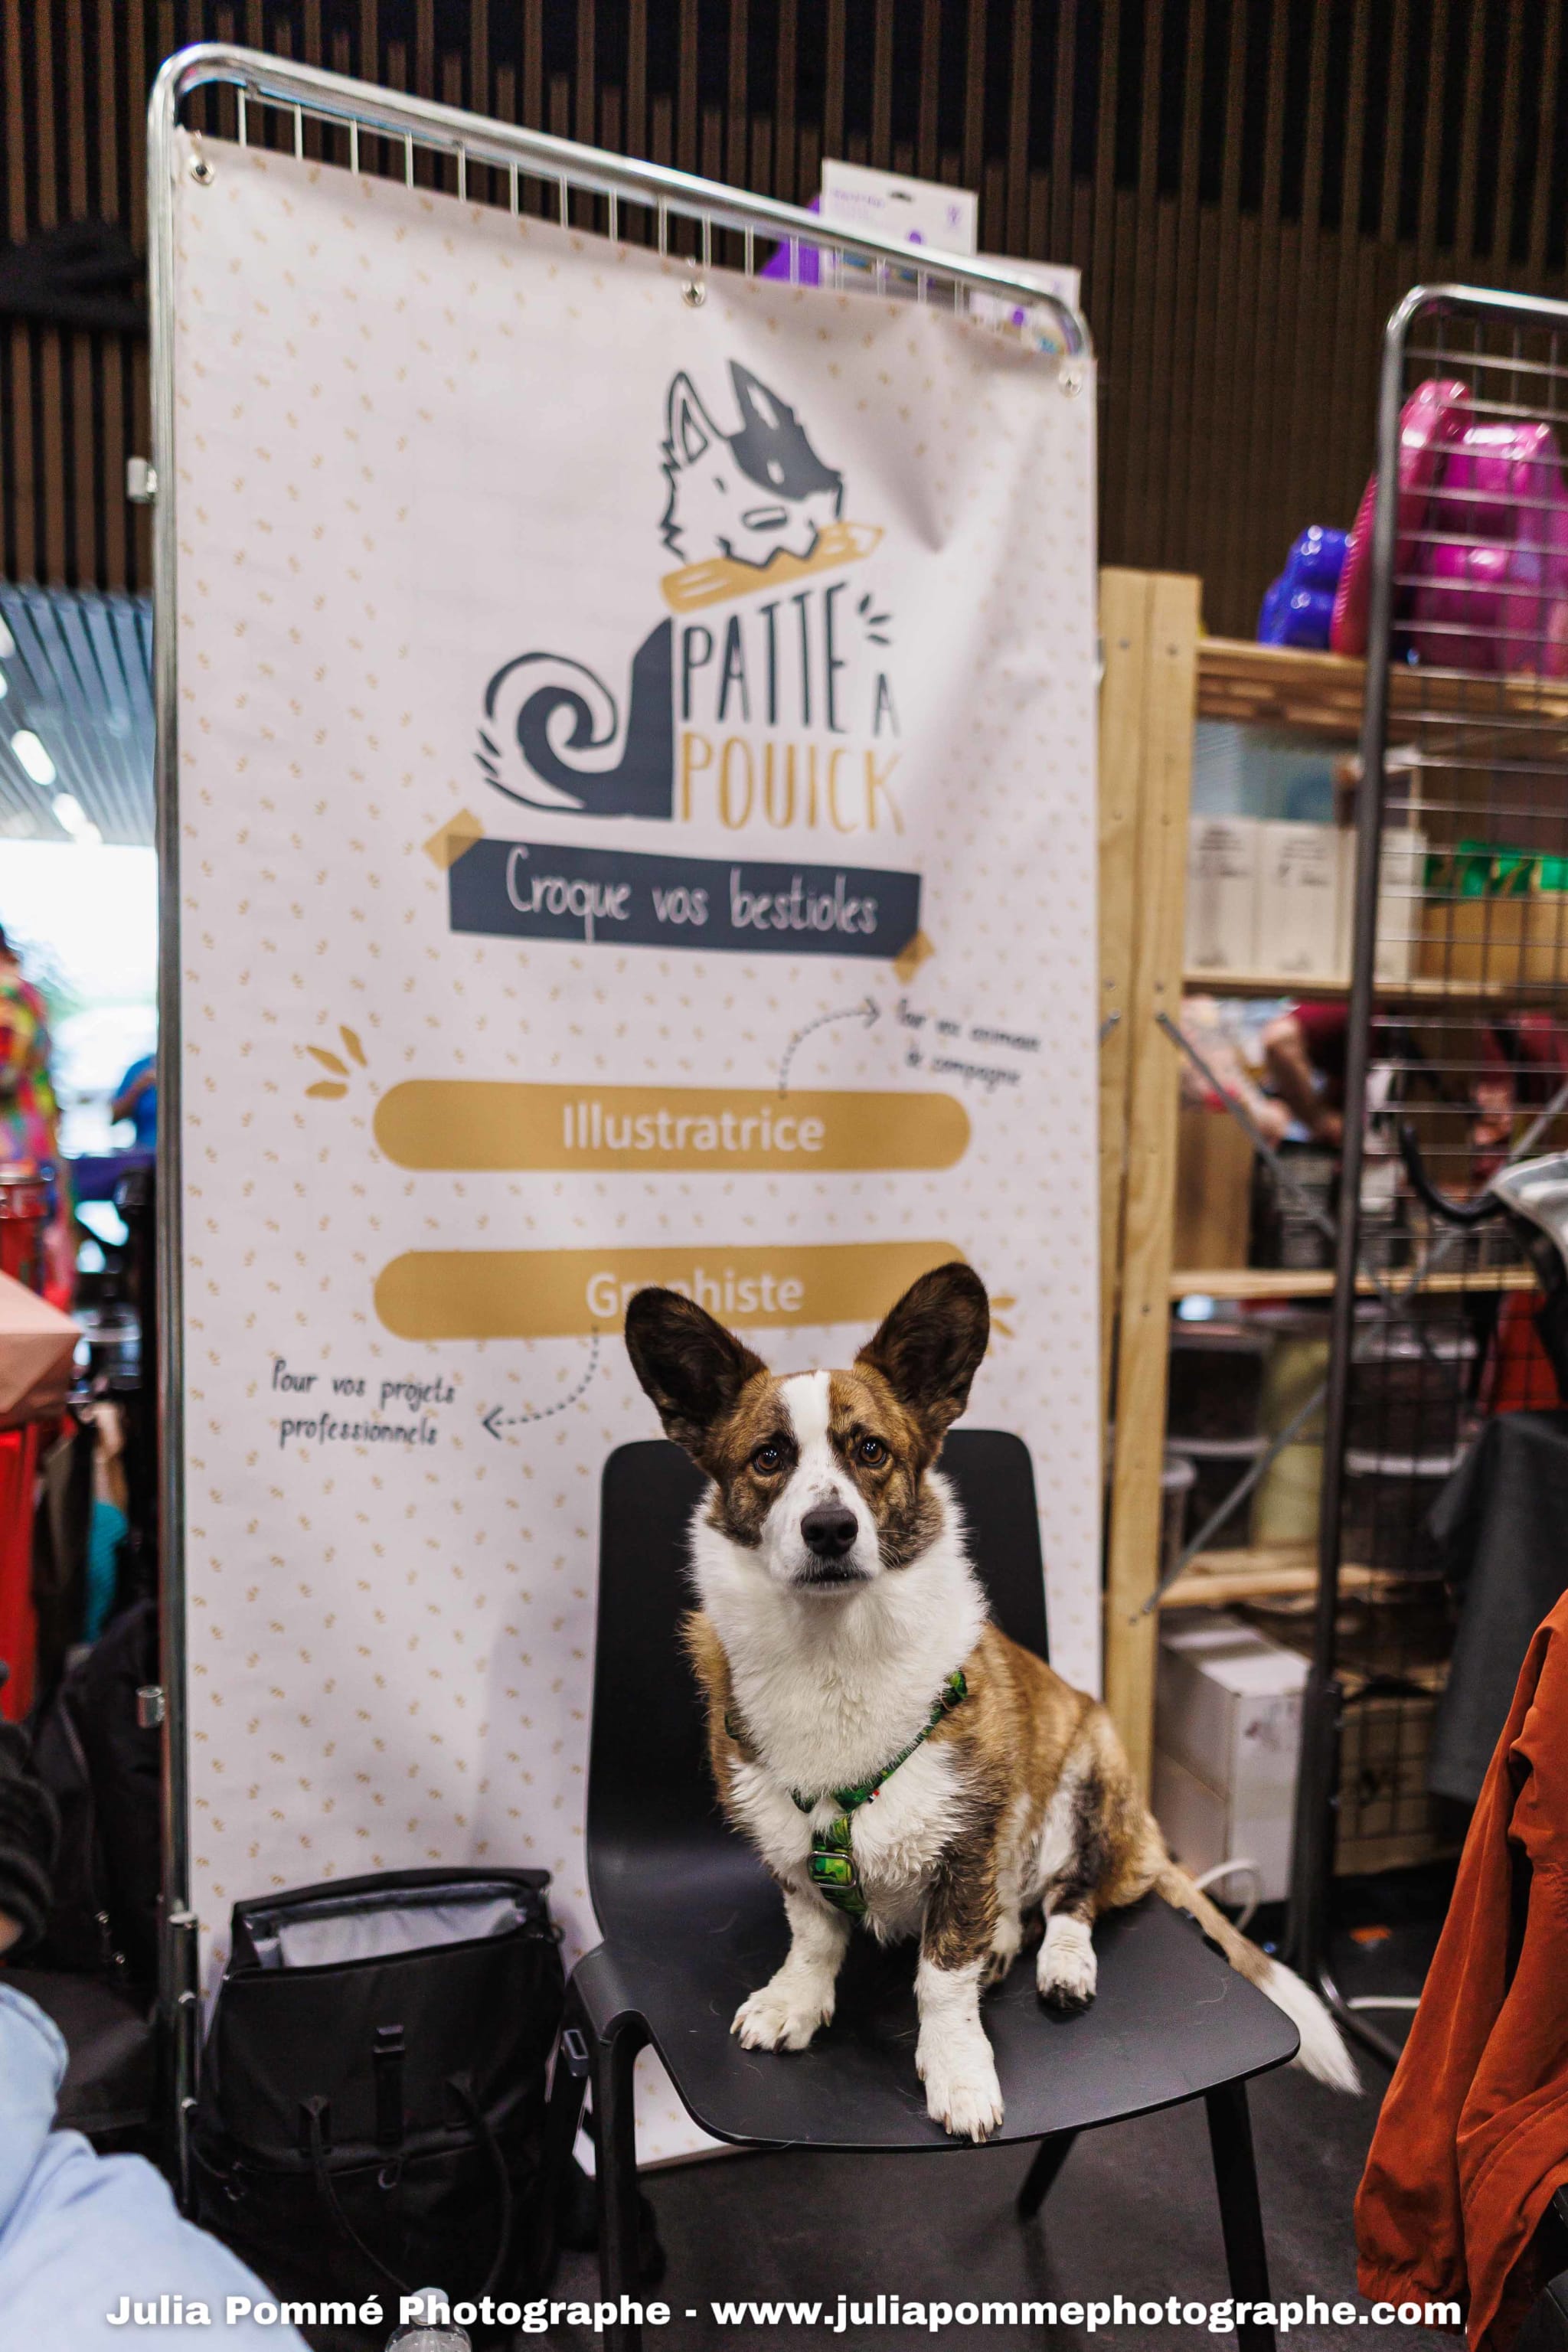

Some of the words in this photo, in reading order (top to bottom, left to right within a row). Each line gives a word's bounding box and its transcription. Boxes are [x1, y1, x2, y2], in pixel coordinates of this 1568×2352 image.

[683, 581, 849, 734] PATTE
[681, 730, 905, 835] POUICK
[506, 844, 631, 944] Croque
[652, 885, 709, 926] vos
[730, 866, 878, 935] bestioles
[562, 1102, 826, 1152] Illustratrice
[586, 1266, 804, 1318] Grhiste
[272, 1357, 318, 1394] Pour
[332, 1377, 366, 1397] vos
[381, 1375, 456, 1412] projets
[279, 1411, 437, 1449] professionnels
